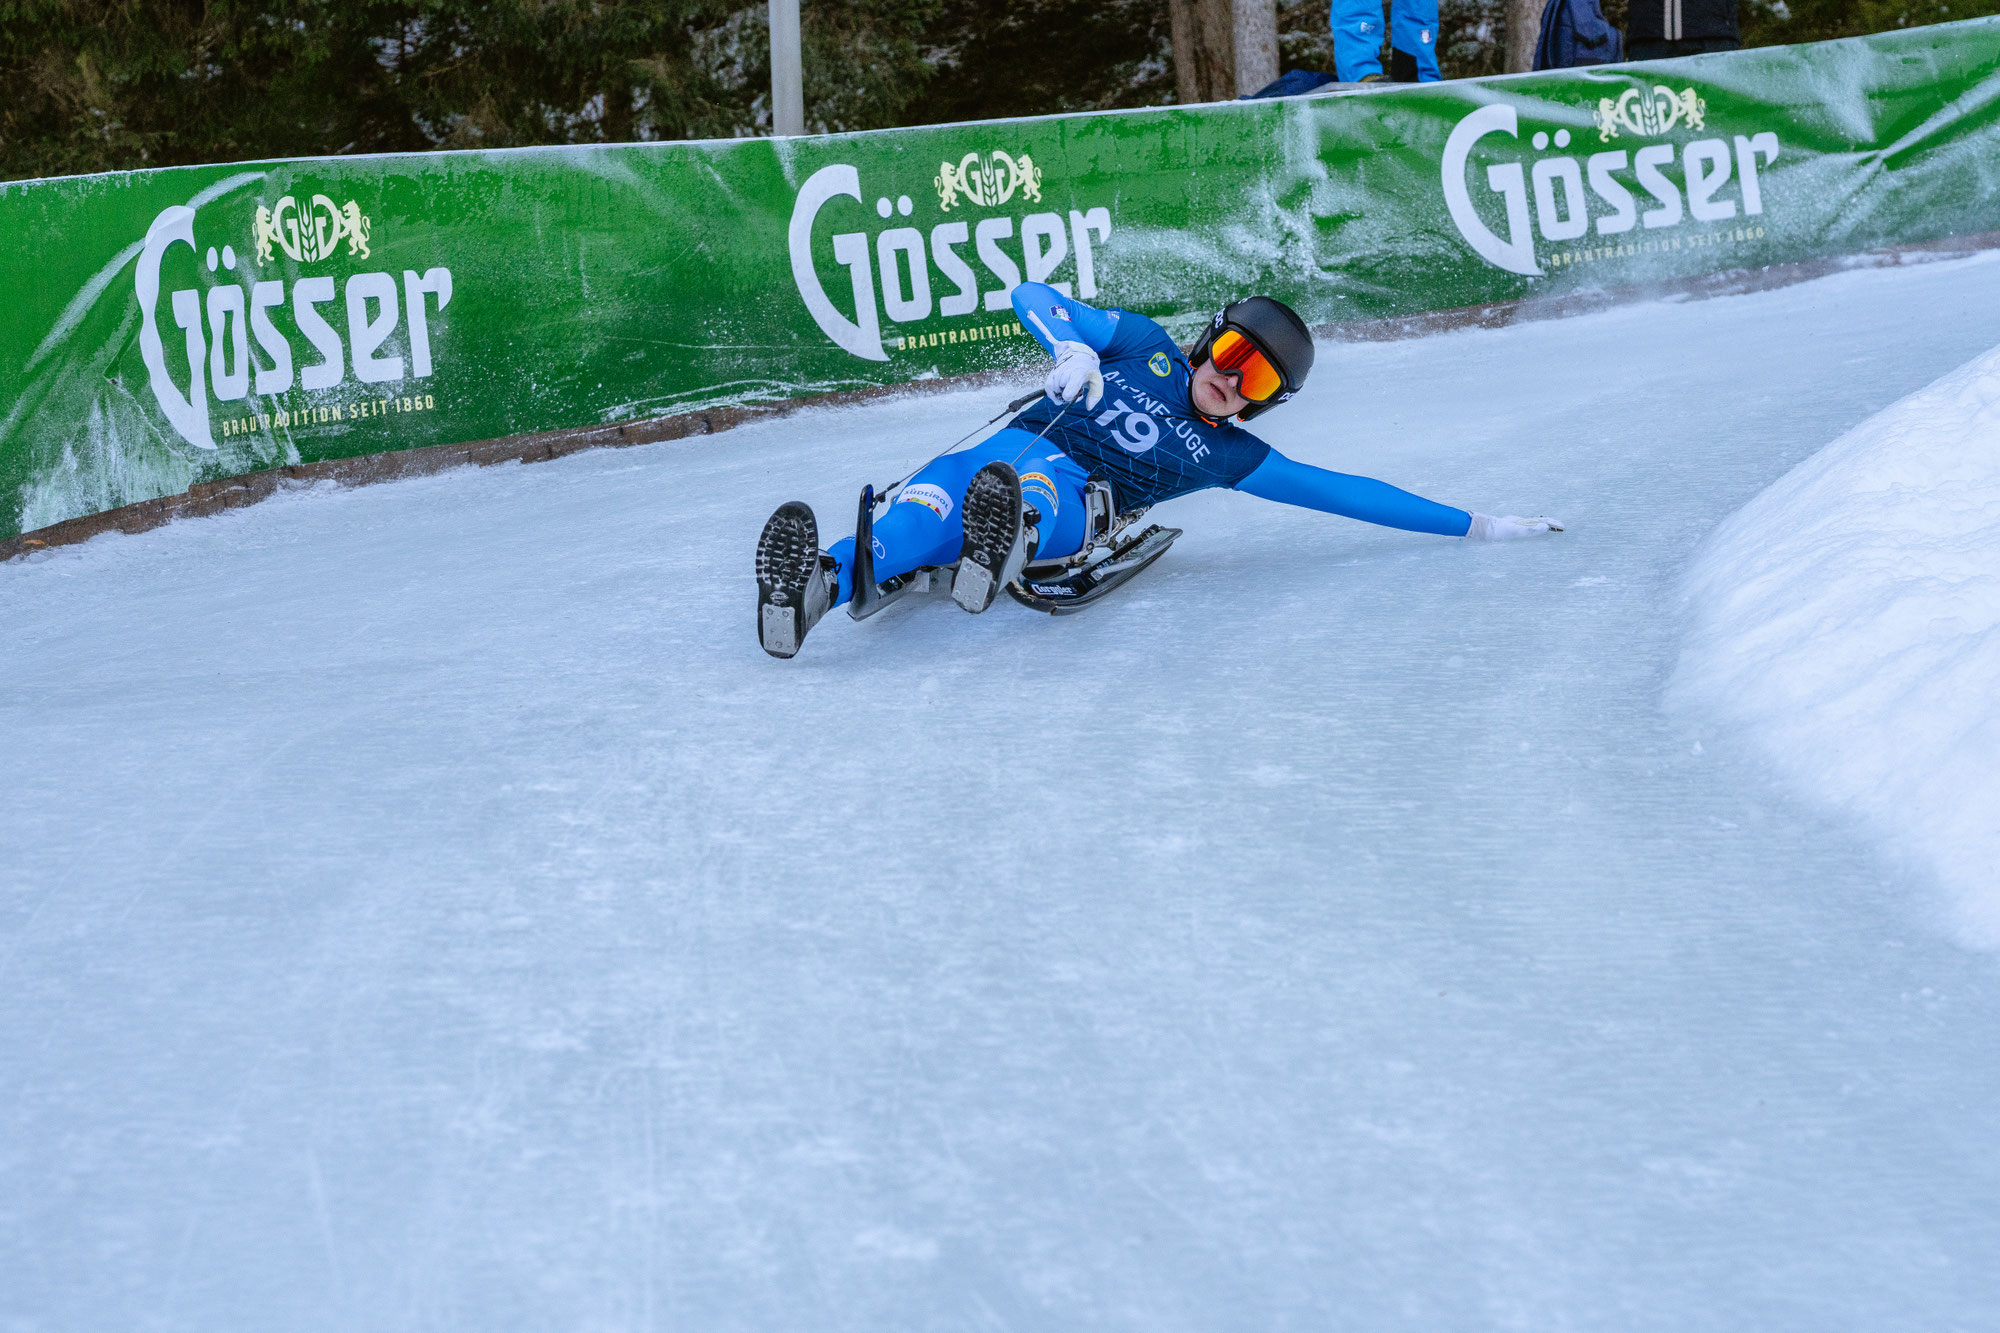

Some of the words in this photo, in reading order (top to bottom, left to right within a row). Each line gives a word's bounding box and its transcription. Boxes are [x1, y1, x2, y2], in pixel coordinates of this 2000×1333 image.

[1441, 103, 1779, 276] Gösser
[788, 163, 1112, 362] Gösser
[1687, 232, 1723, 251] SEIT
[1728, 226, 1765, 244] 1860
[134, 205, 453, 450] Gösser
[897, 321, 1022, 351] BRAUTRADITION
[349, 400, 387, 420] SEIT
[395, 394, 435, 413] 1860
[1094, 398, 1160, 453] 19
